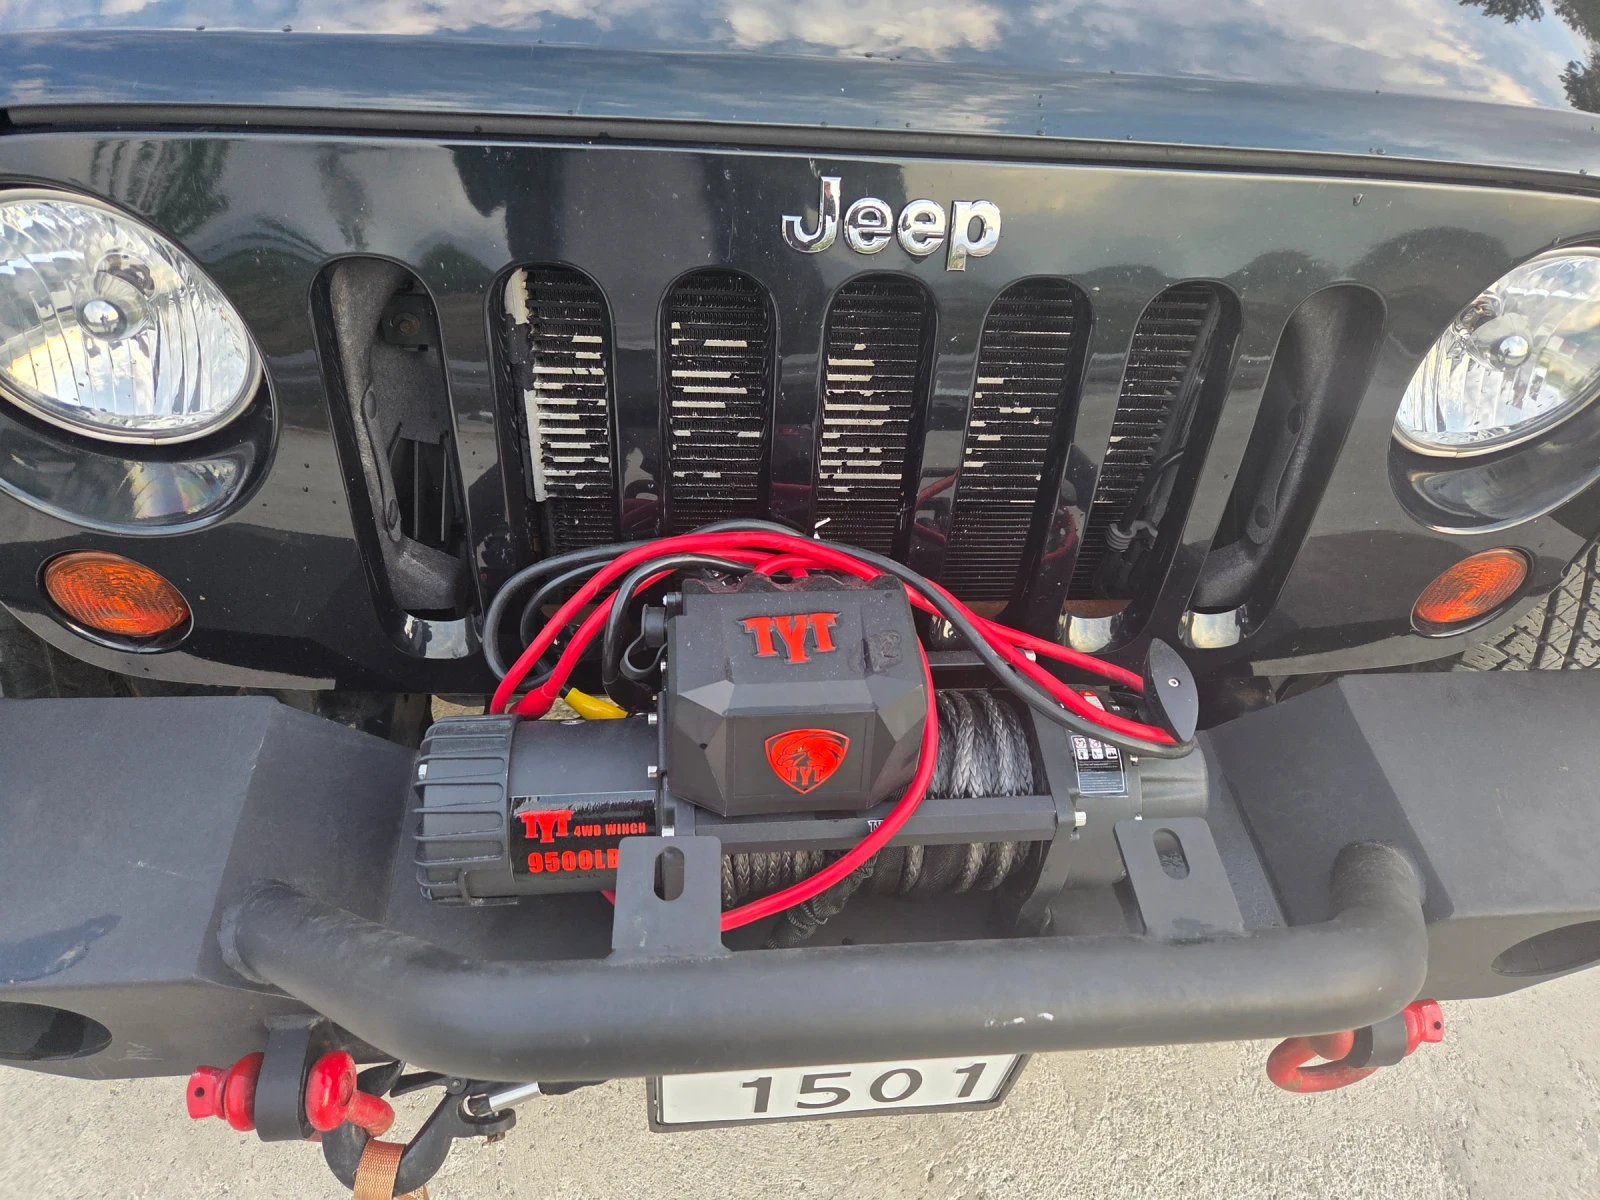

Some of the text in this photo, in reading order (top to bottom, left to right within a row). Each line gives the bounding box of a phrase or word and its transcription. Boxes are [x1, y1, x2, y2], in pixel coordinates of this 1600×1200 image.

[782, 176, 1002, 272] Jeep
[737, 612, 843, 664] TYT
[787, 765, 825, 786] TYT
[517, 809, 646, 843] TYT 4WD WINCH
[741, 1062, 988, 1114] 1501
